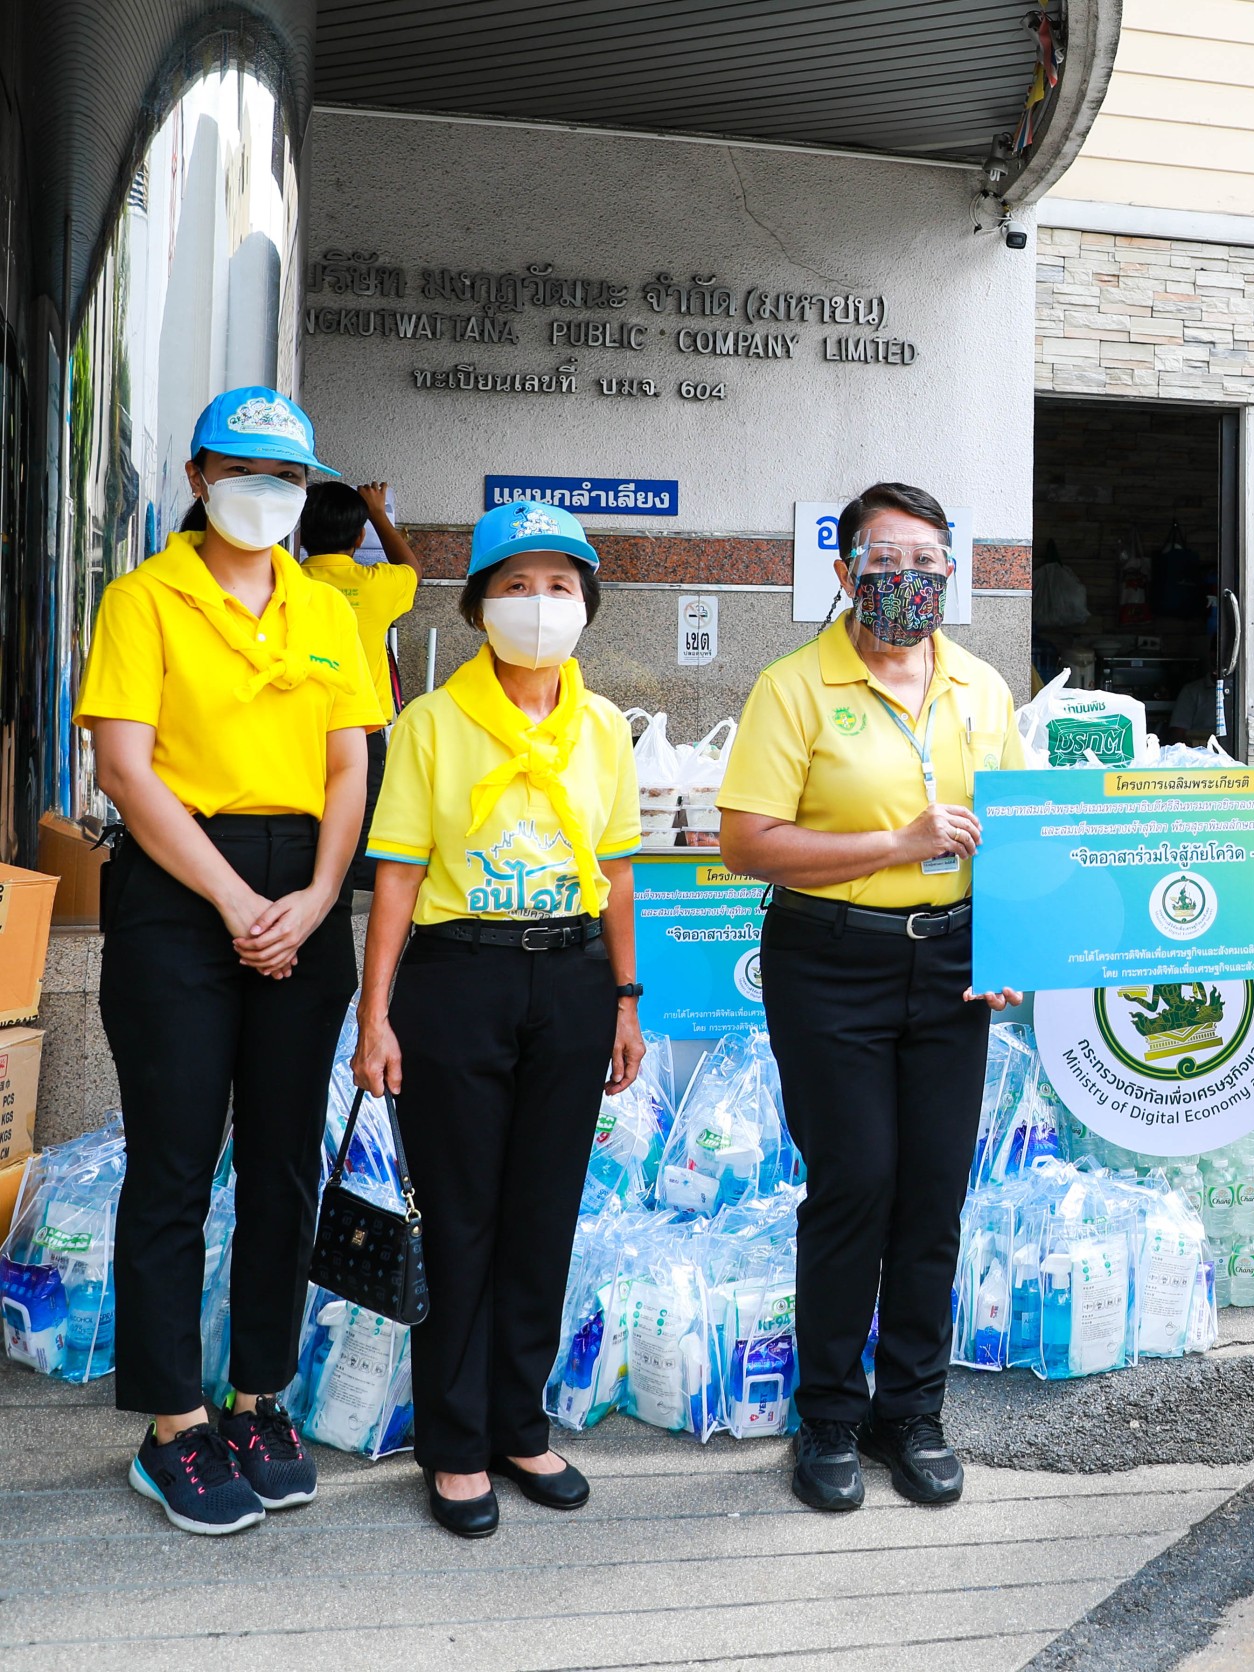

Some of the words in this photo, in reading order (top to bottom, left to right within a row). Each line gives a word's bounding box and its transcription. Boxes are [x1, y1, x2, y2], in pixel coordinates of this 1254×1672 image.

[643, 273, 738, 316] จำกัด
[745, 288, 891, 331] (มหาชน)
[305, 307, 520, 345] NGKUTWATTANA
[551, 320, 648, 350] PUBLIC
[678, 327, 801, 359] COMPANY
[823, 336, 920, 366] LIMITED
[413, 357, 579, 394] ทะเบียนเลขที่
[681, 380, 728, 400] 604
[493, 481, 671, 510] แผนกลำเลียง
[685, 632, 711, 651] เขต
[1116, 775, 1250, 791] โครงการเฉลิมพระเกียรติ
[667, 924, 761, 941] “จิตอาสาร่วมใจ
[1102, 967, 1119, 978] โดย
[663, 1007, 766, 1020] ภายใต้โครงการดิจิทัลเพื่อเศรษ
[1062, 1048, 1110, 1106] Ministry
[1111, 1099, 1129, 1113] of
[1130, 1104, 1180, 1126] Digital
[1185, 1087, 1252, 1124] Economy
[1212, 1197, 1231, 1206] Chang
[1235, 1266, 1254, 1275] Chang
